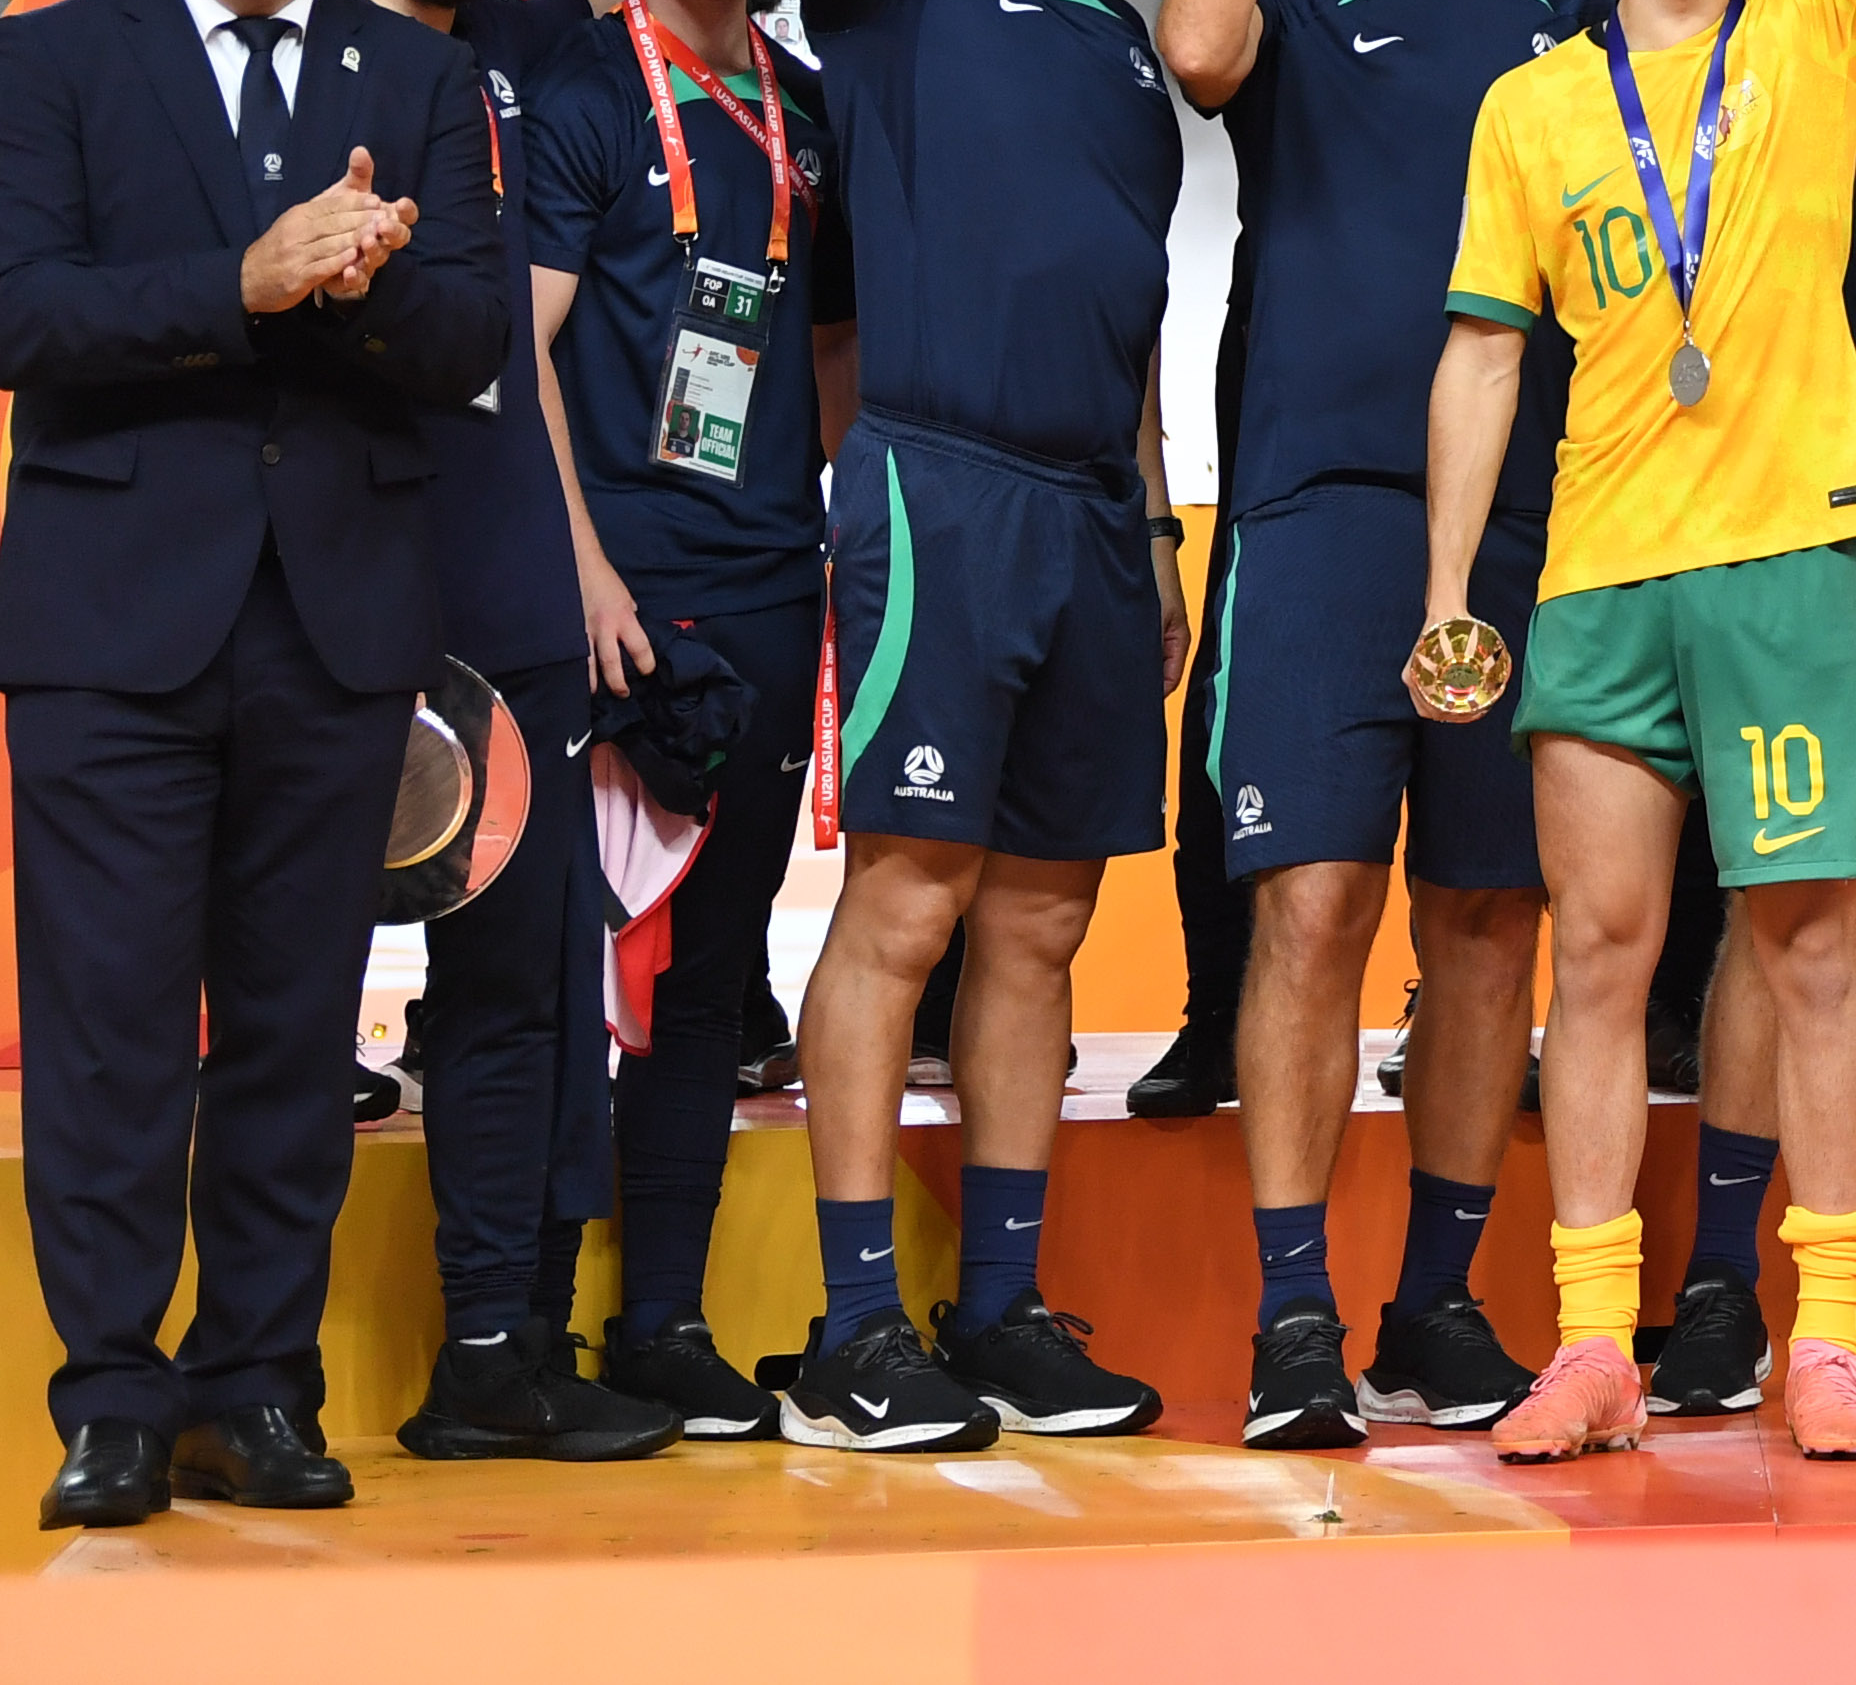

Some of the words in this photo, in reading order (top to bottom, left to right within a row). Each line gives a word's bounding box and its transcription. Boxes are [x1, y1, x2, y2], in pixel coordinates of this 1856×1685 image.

[639, 33, 657, 60] CUP
[735, 110, 766, 145] ASIAN
[766, 103, 779, 133] CUP
[1632, 136, 1657, 169] AFC
[1694, 125, 1713, 161] AFC
[1573, 205, 1652, 311] 10
[1685, 251, 1700, 290] AFC
[703, 277, 723, 292] FOP
[701, 294, 716, 308] OA
[733, 295, 753, 317] 31
[700, 436, 736, 461] OFFICIAL
[709, 423, 734, 444] TEAM
[821, 698, 834, 729] CUP
[821, 729, 834, 772] ASIAN
[1740, 724, 1823, 819] 10
[821, 772, 834, 803] U20
[892, 784, 955, 802] AUSTRALIA
[1232, 821, 1278, 841] AUSTRALIA
